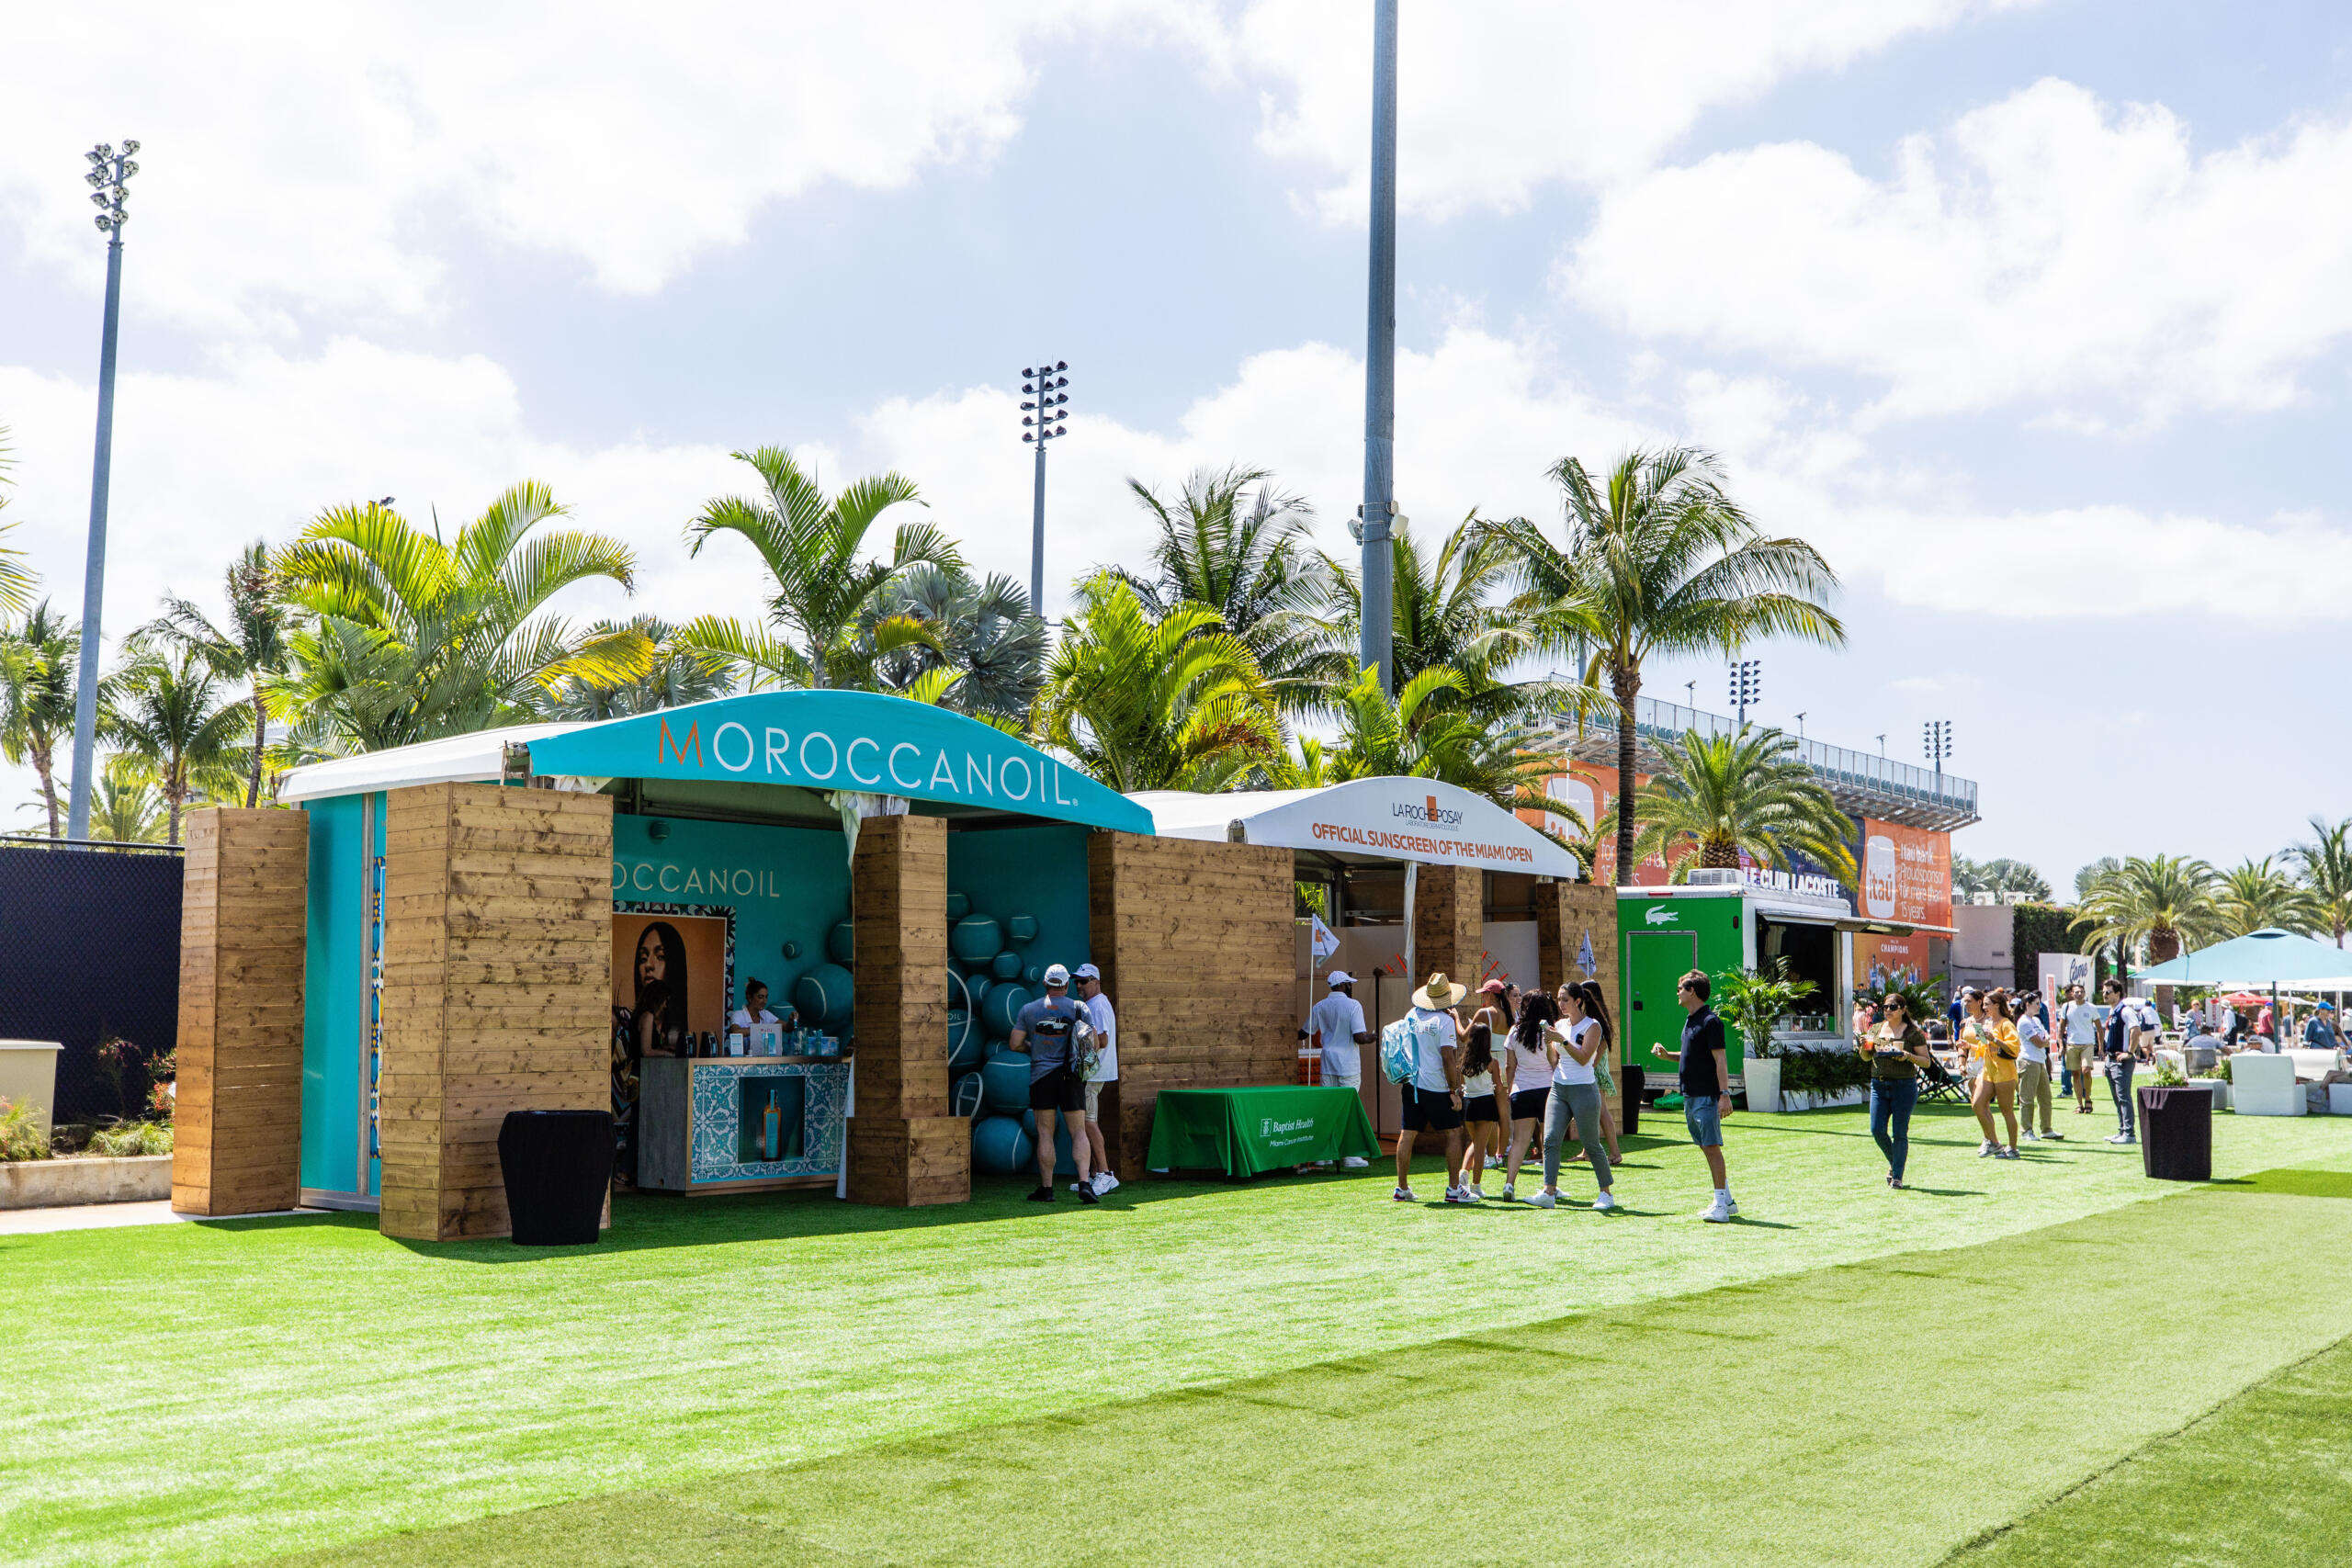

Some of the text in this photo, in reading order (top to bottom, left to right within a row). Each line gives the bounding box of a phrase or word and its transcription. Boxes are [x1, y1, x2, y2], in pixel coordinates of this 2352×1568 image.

[1392, 802, 1464, 825] LA ROCHE POSAY
[1312, 822, 1533, 863] OFFICIAL SUNSCREEN OF THE MIAMI OPEN
[1601, 838, 1616, 862] for
[1916, 845, 1933, 864] bank
[1744, 866, 1839, 898] LE CLUB LACOSTE
[1901, 863, 1945, 885] Proud sponsor
[1868, 869, 1893, 902] itaú
[1899, 880, 1942, 902] for more than
[1900, 901, 1907, 918] 15
[1881, 943, 1909, 954] CHAMPIONS
[1272, 1117, 1314, 1134] Baptist Health
